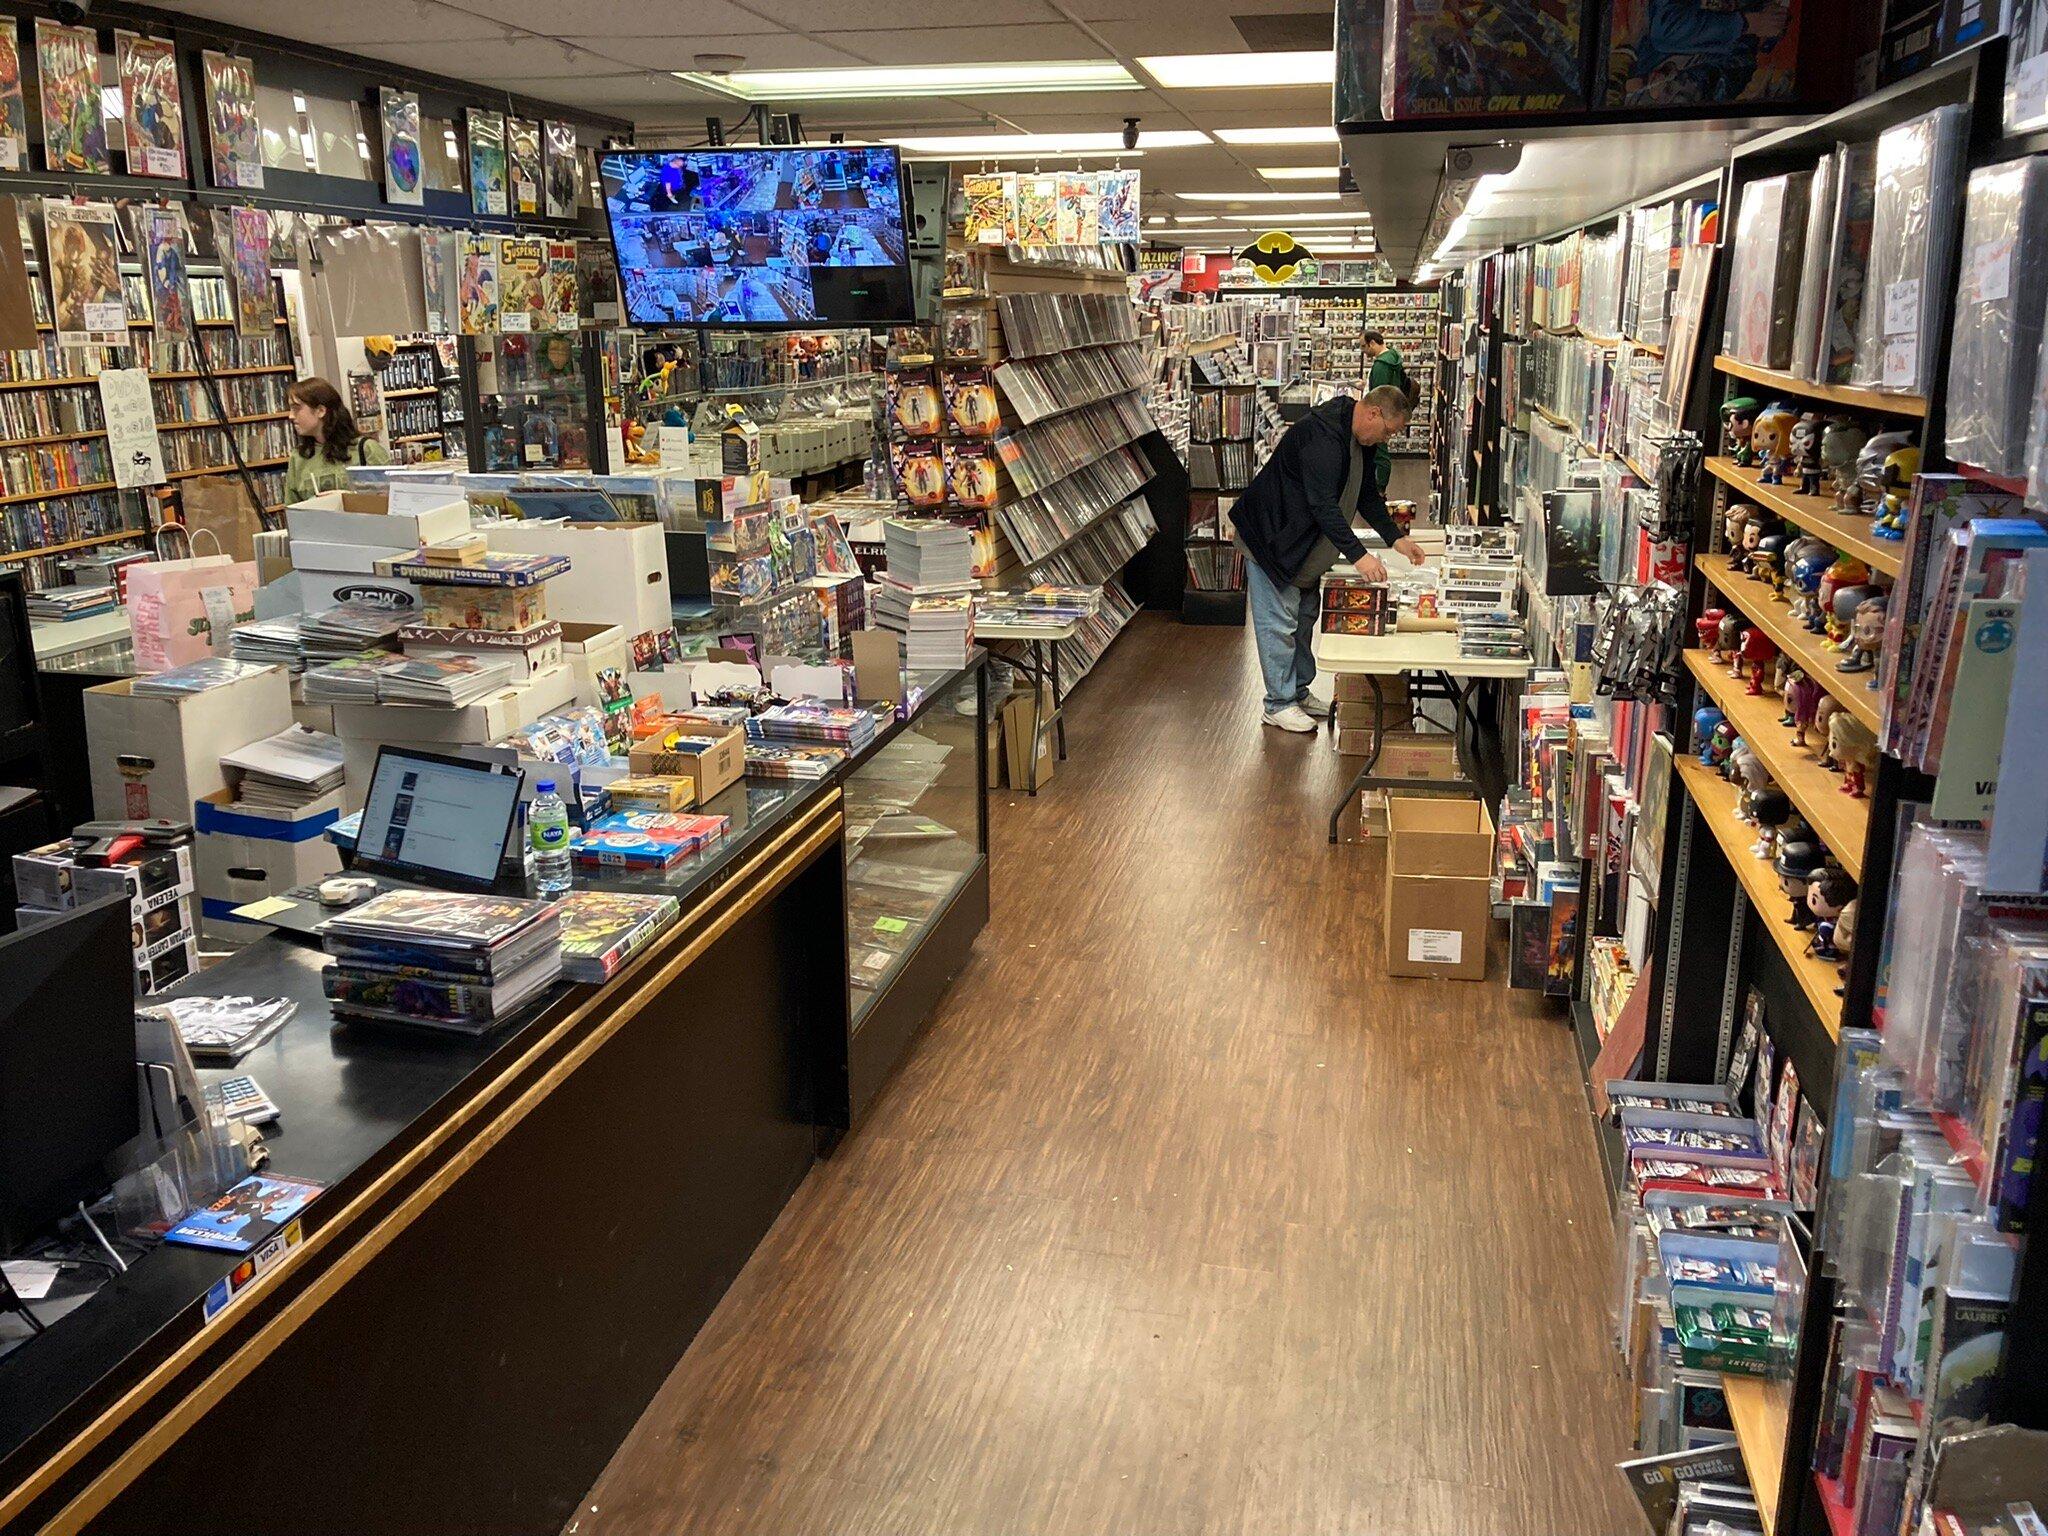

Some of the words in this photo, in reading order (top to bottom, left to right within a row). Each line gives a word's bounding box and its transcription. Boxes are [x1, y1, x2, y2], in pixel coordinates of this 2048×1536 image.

[1411, 98, 1449, 113] SPECIAL
[1488, 95, 1521, 111] CIVIL
[502, 240, 541, 262] SUSPENSE
[1140, 251, 1177, 262] AZING
[400, 566, 455, 579] DYNOMUTT
[542, 830, 563, 838] NAYA
[147, 888, 179, 908] YELENA
[169, 926, 192, 948] CAPTAIN
[148, 943, 169, 958] CARTER
[260, 1242, 279, 1262] VISA
[1643, 1470, 1665, 1485] GO
[1673, 1465, 1695, 1479] GO
